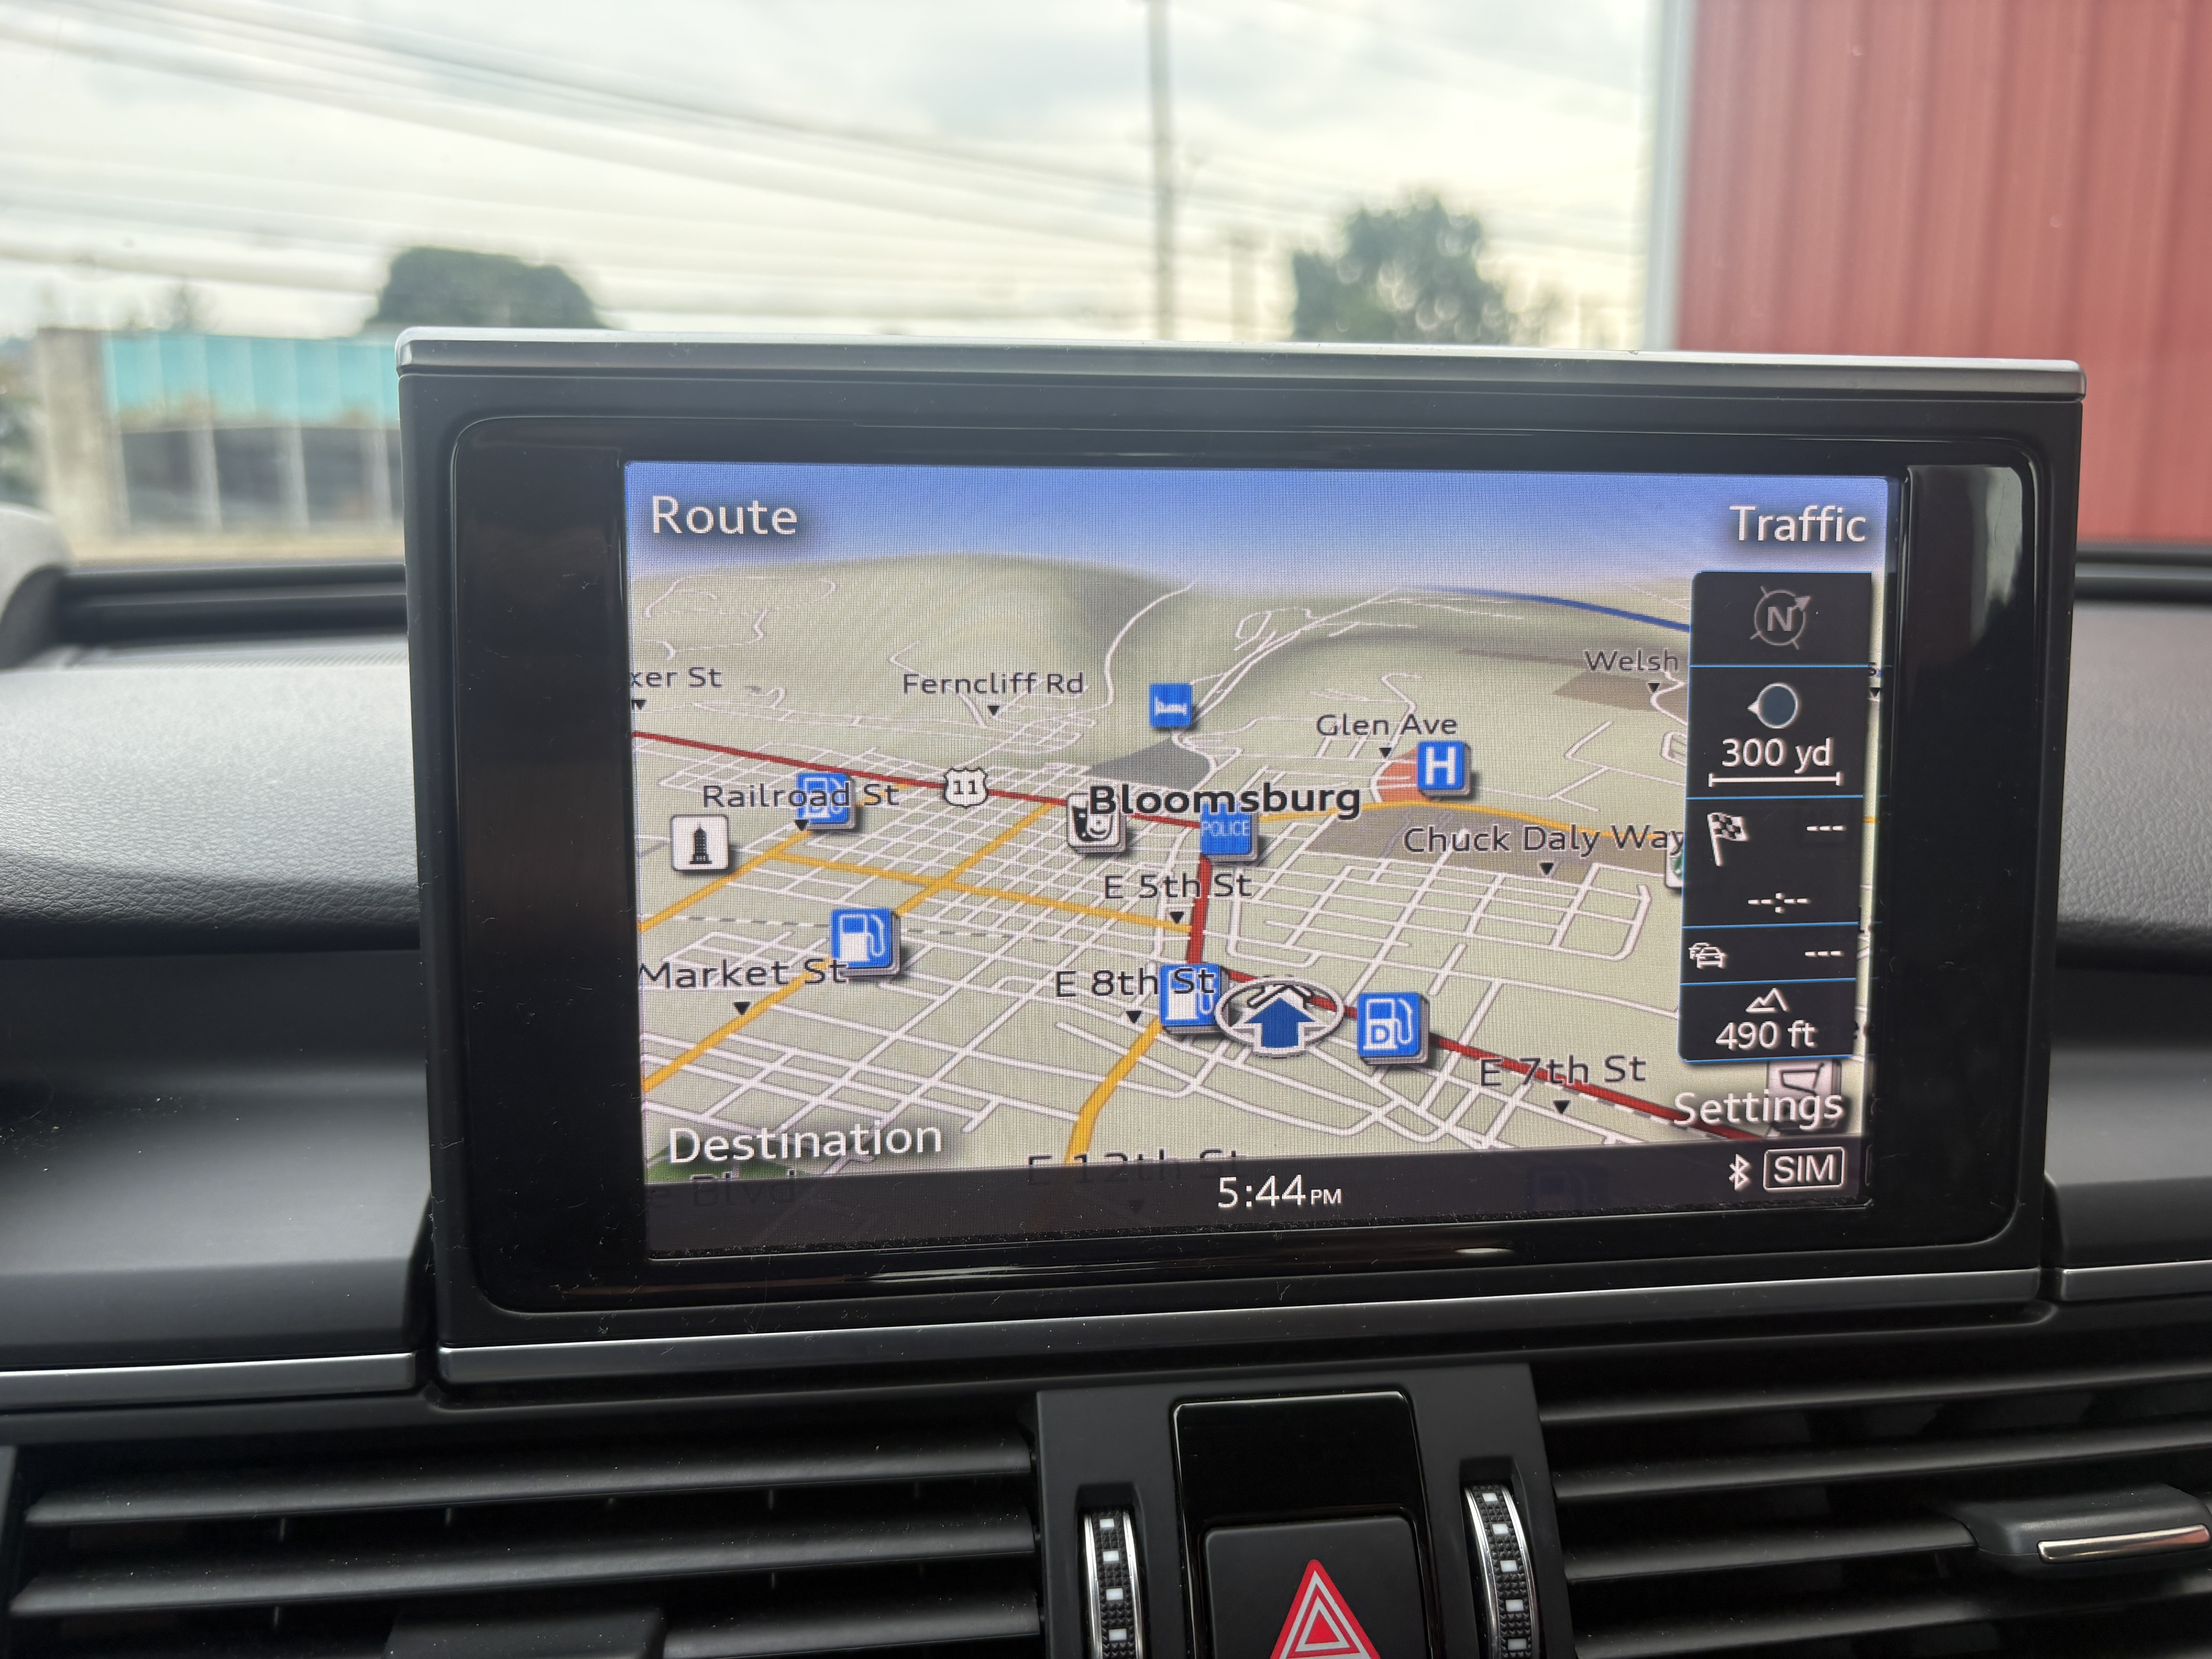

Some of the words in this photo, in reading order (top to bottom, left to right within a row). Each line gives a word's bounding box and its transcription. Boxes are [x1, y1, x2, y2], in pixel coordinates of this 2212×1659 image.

[652, 495, 798, 535] Route
[1729, 504, 1867, 542] Traffic
[1584, 649, 1678, 672] Welsh
[689, 667, 722, 688] St
[903, 672, 1037, 694] Ferncliff
[1046, 672, 1084, 694] Rd
[1316, 714, 1389, 736] Glen
[1401, 713, 1458, 735] Ave
[1424, 746, 1457, 785] H
[1722, 737, 1783, 768] 300
[1794, 737, 1834, 774] yd
[702, 781, 850, 808] Railroad
[863, 783, 900, 806] St
[953, 780, 977, 795] 11
[1090, 782, 1360, 820] Bloomsburg
[1201, 821, 1250, 836] POLICE
[1404, 825, 1510, 853] Chuck
[1523, 824, 1601, 857] Daly
[1611, 824, 1684, 857] Way
[1105, 874, 1123, 900] E
[1140, 872, 1200, 898] 5th
[1214, 873, 1252, 897] St
[639, 959, 790, 988] Market
[804, 958, 848, 984] St
[1056, 970, 1078, 998] E
[1091, 967, 1159, 996] 8th
[1173, 967, 1216, 994] St
[1715, 1021, 1778, 1051] 490
[1788, 1019, 1817, 1049] ft
[1480, 1058, 1503, 1087] E
[1520, 1055, 1589, 1085] 7th
[1603, 1055, 1647, 1083] St
[1673, 1089, 1844, 1130] Settings
[669, 1119, 942, 1164] Destination
[1774, 1155, 1834, 1185] SIM
